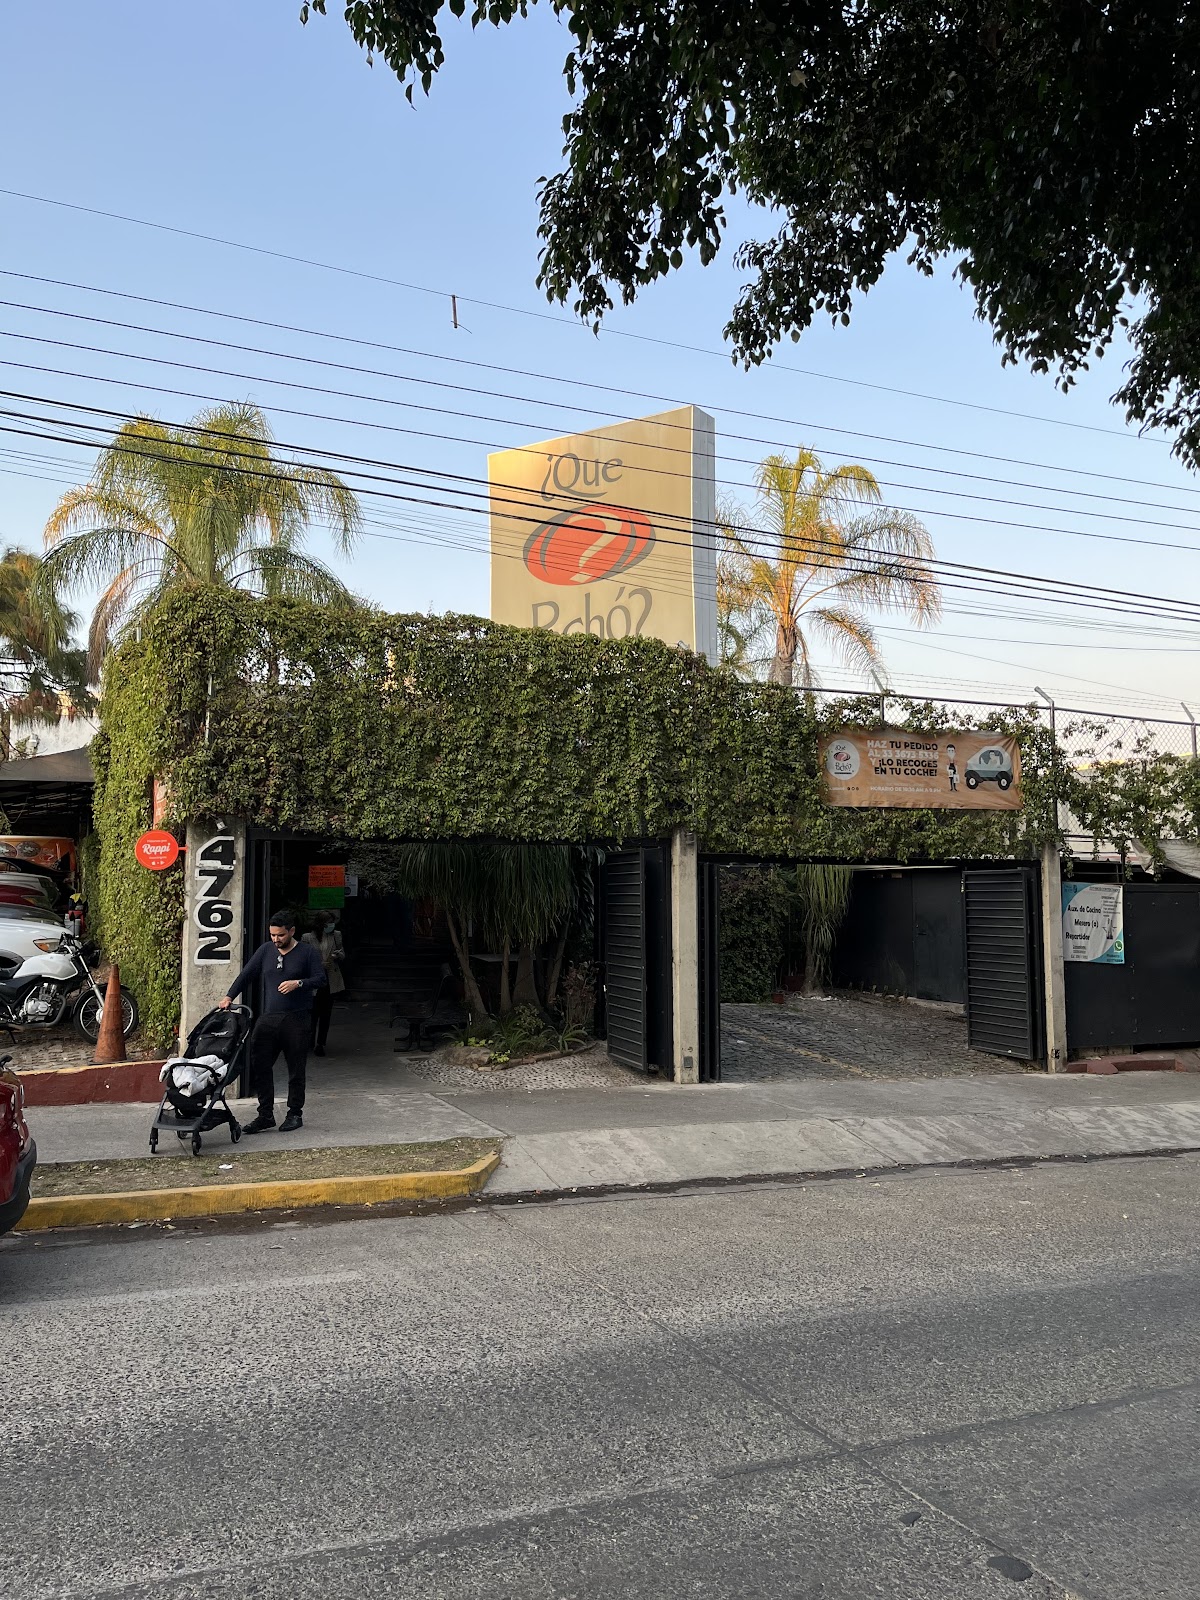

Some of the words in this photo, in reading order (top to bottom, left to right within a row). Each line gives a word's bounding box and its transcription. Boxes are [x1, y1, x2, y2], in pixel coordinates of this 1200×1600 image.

[540, 452, 623, 502] ¿Que
[867, 740, 886, 748] HAZ
[890, 741, 901, 749] TU
[904, 742, 938, 751] PEDIDO
[882, 749, 893, 758] 33
[870, 758, 876, 766] Y
[879, 758, 894, 767] ¡LO
[896, 758, 938, 768] RECOGES
[889, 767, 901, 775] TU
[904, 768, 937, 776] COCHE!
[142, 843, 171, 855] Rappi
[195, 835, 237, 966] 4762
[1066, 932, 1090, 940] Repartidor
